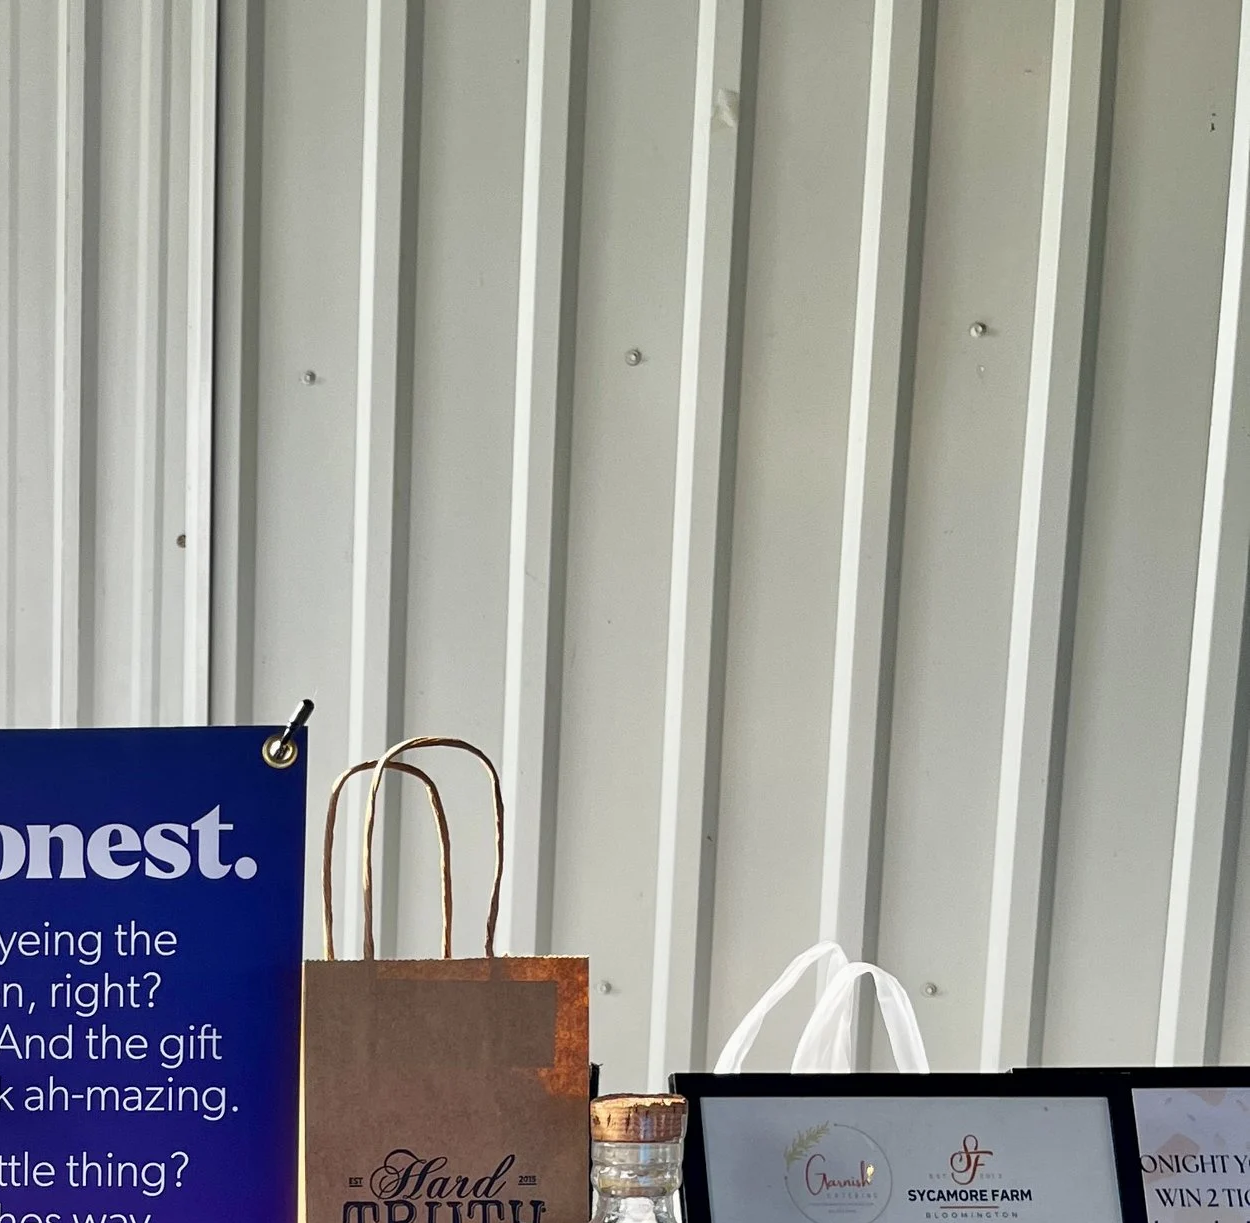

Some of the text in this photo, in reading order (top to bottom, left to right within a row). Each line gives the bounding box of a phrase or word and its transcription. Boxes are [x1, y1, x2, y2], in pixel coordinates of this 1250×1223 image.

[114, 920, 177, 956] the
[51, 971, 162, 1018] right?
[85, 1023, 148, 1060] the
[159, 1023, 223, 1069] gift
[24, 1075, 239, 1121] ah-mazing.
[65, 1151, 189, 1197] thing?
[348, 1177, 363, 1185] EST
[370, 1149, 515, 1200] Hard
[908, 1189, 1032, 1202] SYCAMORE FARM
[1155, 1189, 1201, 1207] WIN
[1207, 1189, 1219, 1207] 2
